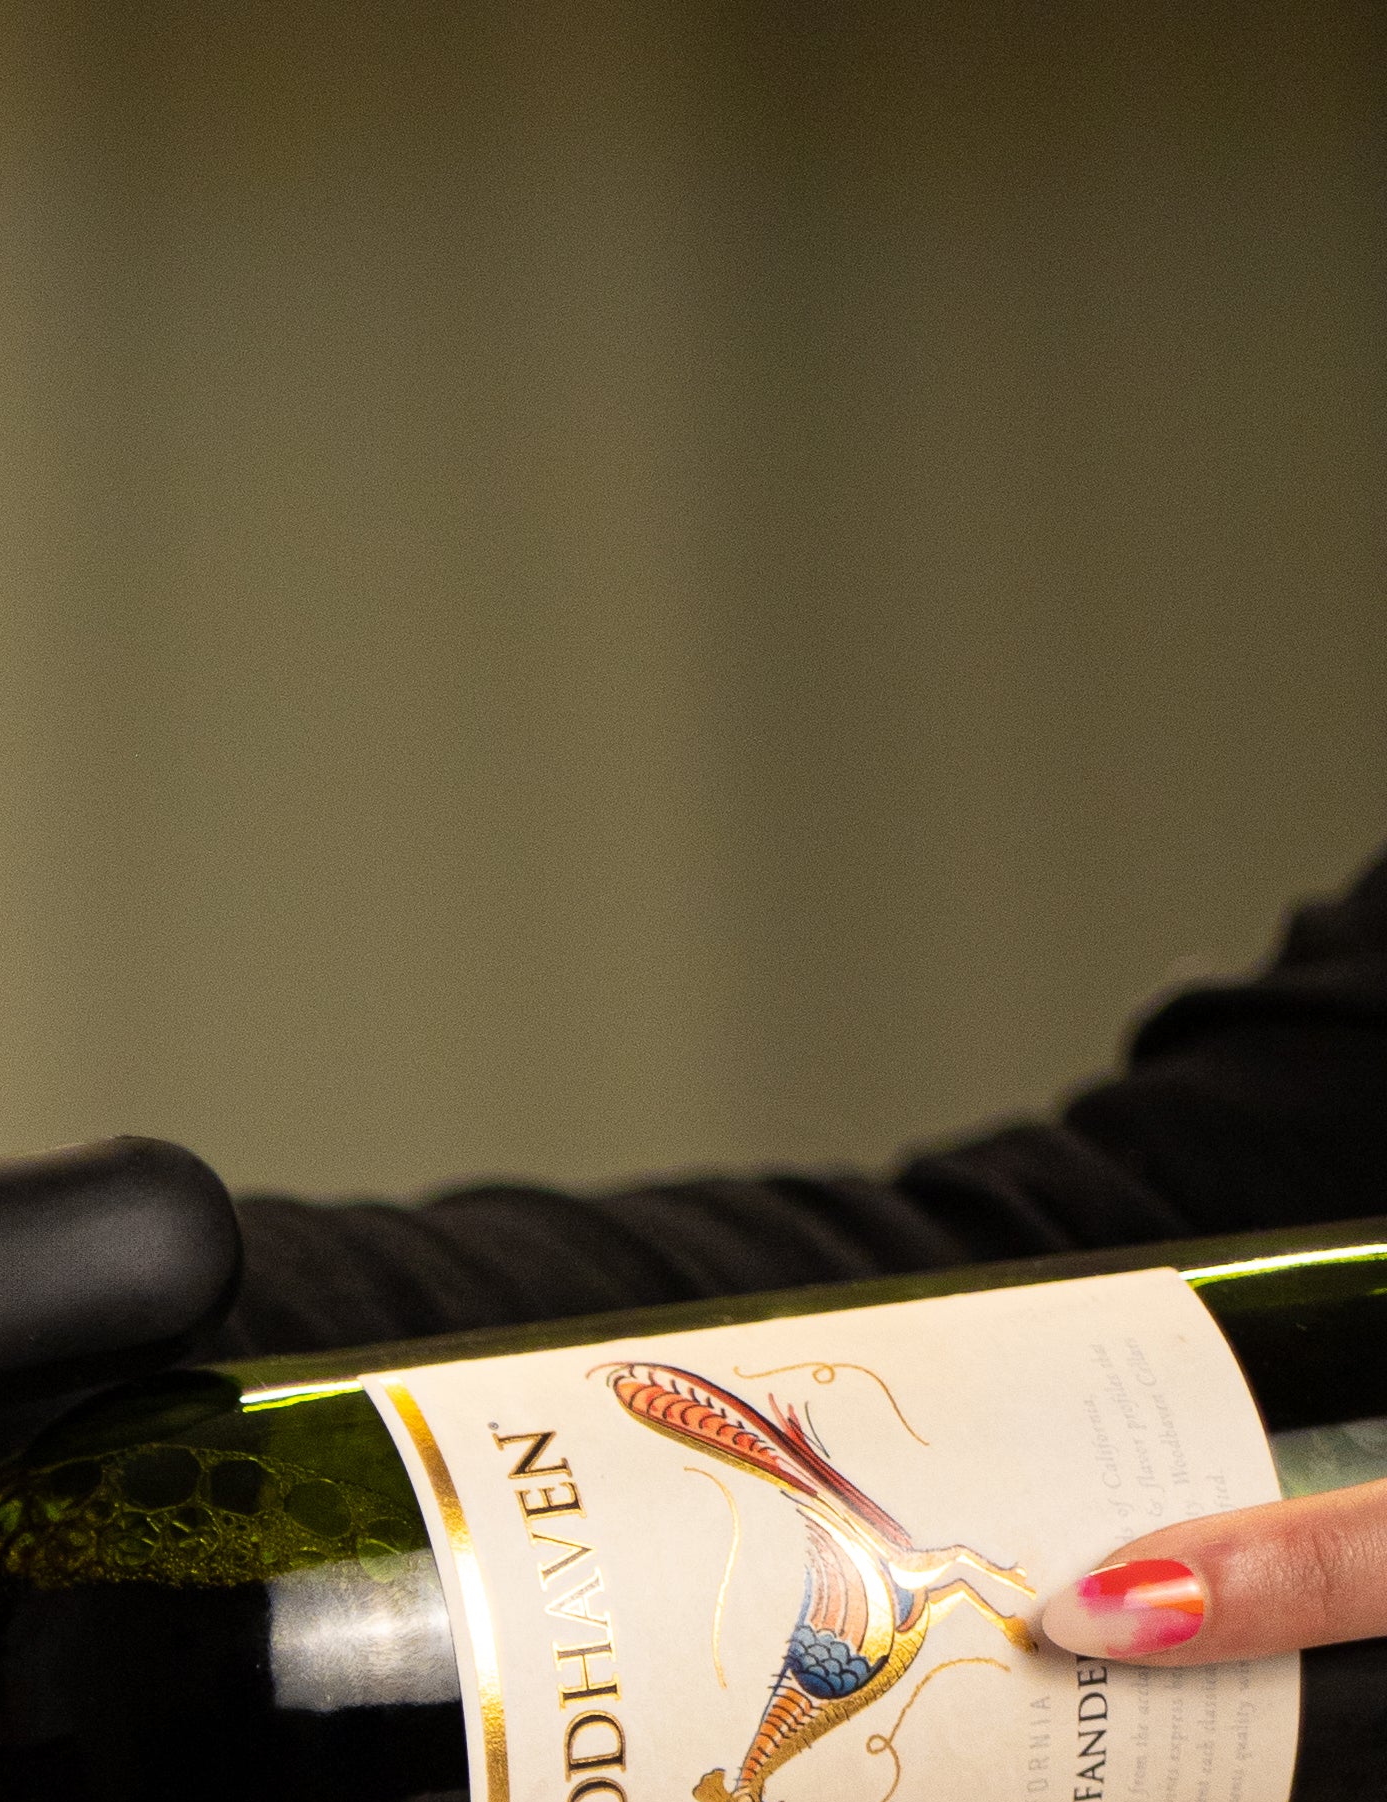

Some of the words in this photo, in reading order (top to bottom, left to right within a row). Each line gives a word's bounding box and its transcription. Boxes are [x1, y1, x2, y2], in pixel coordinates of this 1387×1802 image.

[1105, 1373, 1148, 1431] profiles
[1133, 1437, 1166, 1494] flavor
[1153, 1393, 1190, 1485] Woodhaven
[1108, 1498, 1133, 1518] of
[1229, 1701, 1256, 1761] quality
